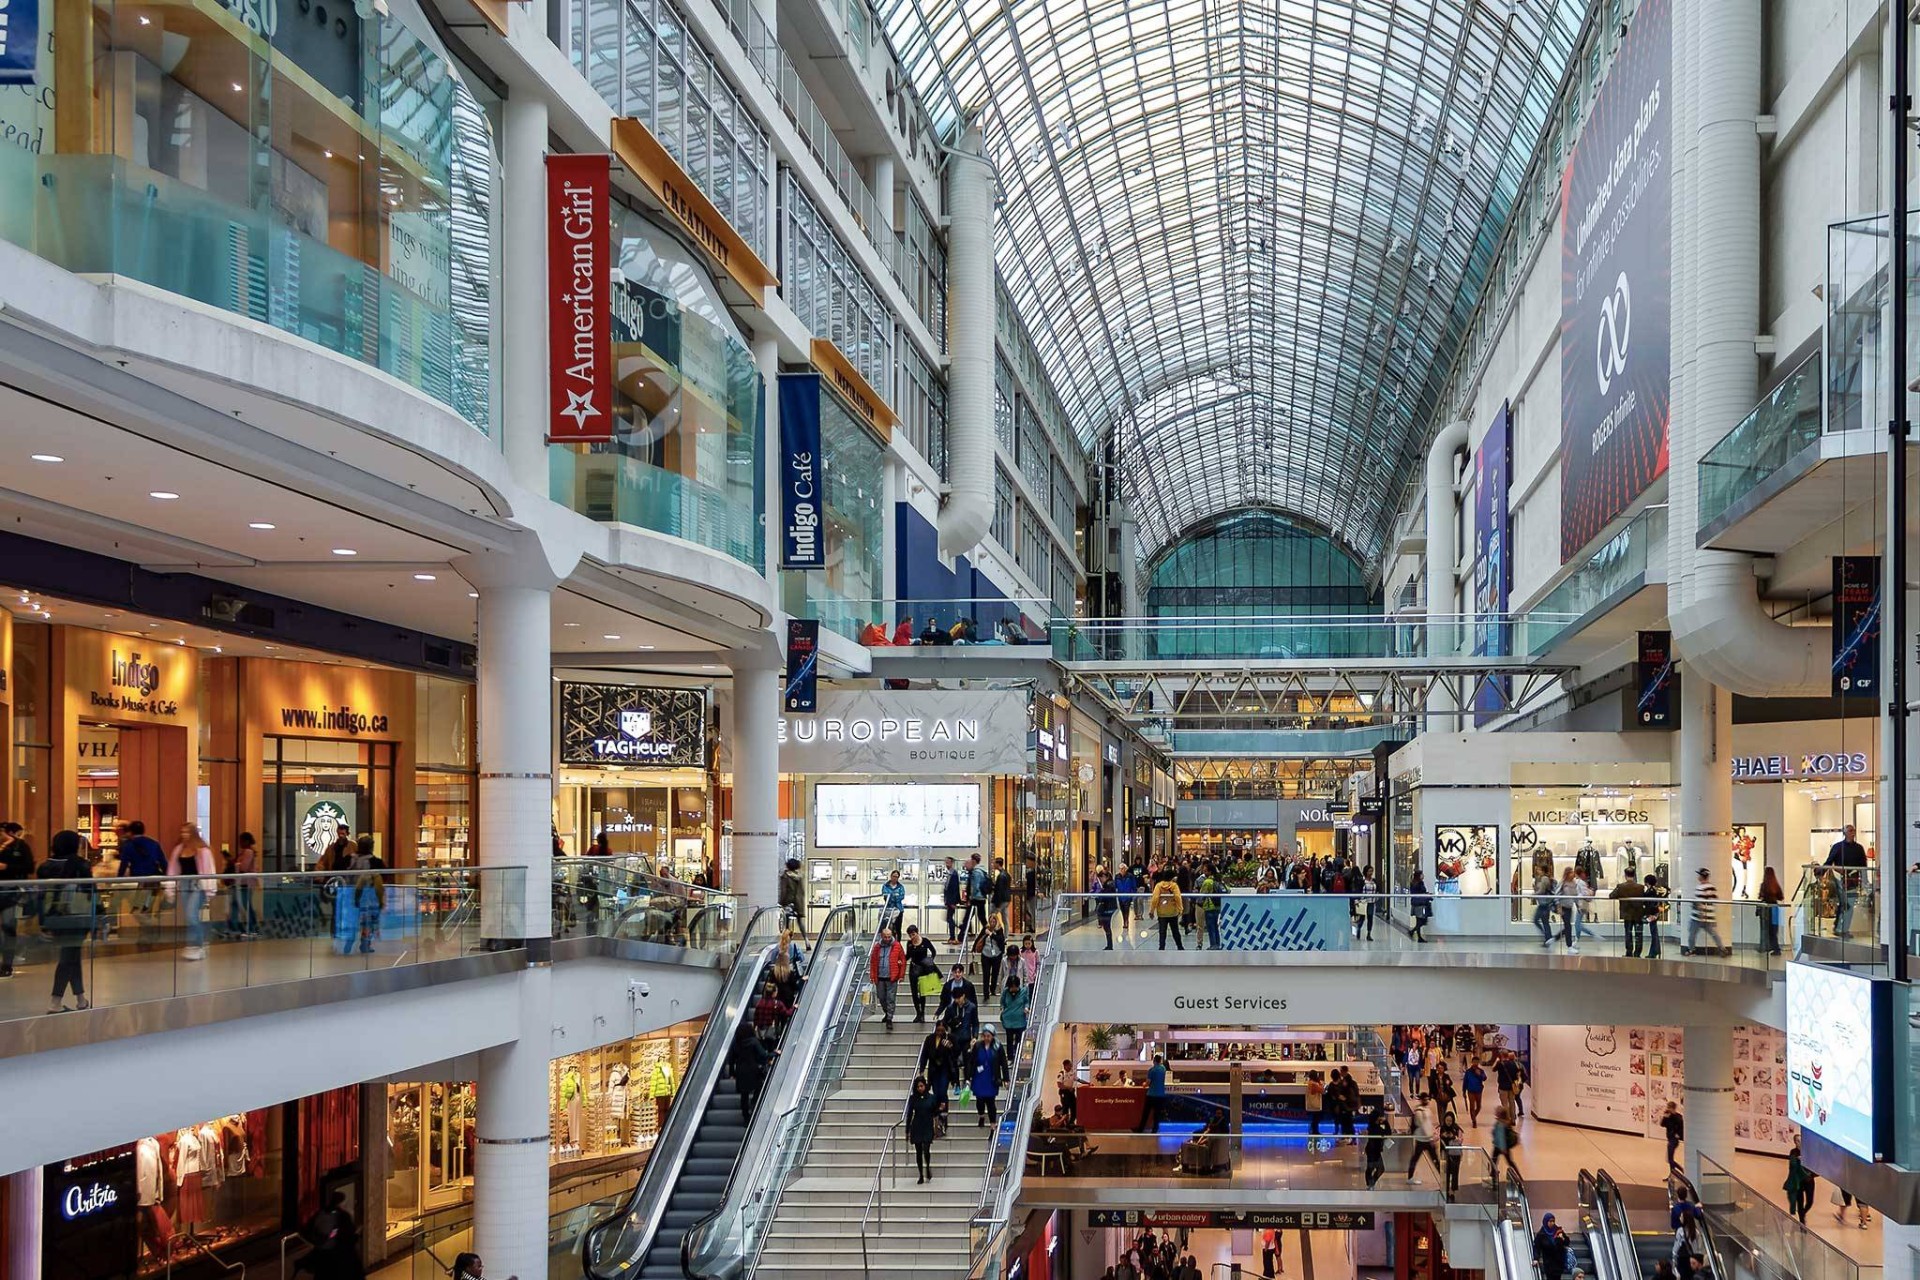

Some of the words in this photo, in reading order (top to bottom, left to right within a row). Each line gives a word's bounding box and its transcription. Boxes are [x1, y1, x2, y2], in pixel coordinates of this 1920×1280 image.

[1576, 158, 1612, 256] Unlimited
[1613, 135, 1632, 188] data
[1633, 79, 1660, 162] plans
[661, 180, 730, 267] CREATIVITY
[1576, 268, 1586, 306] for
[1586, 228, 1610, 286] infinite
[561, 242, 594, 385] American
[833, 367, 876, 422] INSPIRATION
[794, 451, 813, 499] Café
[789, 502, 818, 561] Indigo
[111, 649, 160, 697] Indigo
[90, 690, 120, 708] Books
[121, 695, 149, 713] Music
[158, 700, 178, 716] Café
[281, 705, 389, 735] www.indigo.ca
[910, 750, 976, 760] BOUTIQUE
[1801, 752, 1868, 775] KORS
[606, 823, 653, 832] ZENITH
[1604, 809, 1649, 822] KORS
[1438, 839, 1462, 853] MK
[1173, 996, 1219, 1010] Guest
[1224, 995, 1288, 1010] Services
[1580, 1060, 1594, 1069] Body
[1595, 1062, 1621, 1071] Cosmetics
[1587, 1069, 1600, 1077] Soul
[1601, 1071, 1614, 1079] Care
[66, 1182, 118, 1216] Aritzia
[1182, 1214, 1206, 1222] eatery
[1253, 1214, 1284, 1223] Dundas
[1285, 1215, 1295, 1223] St.
